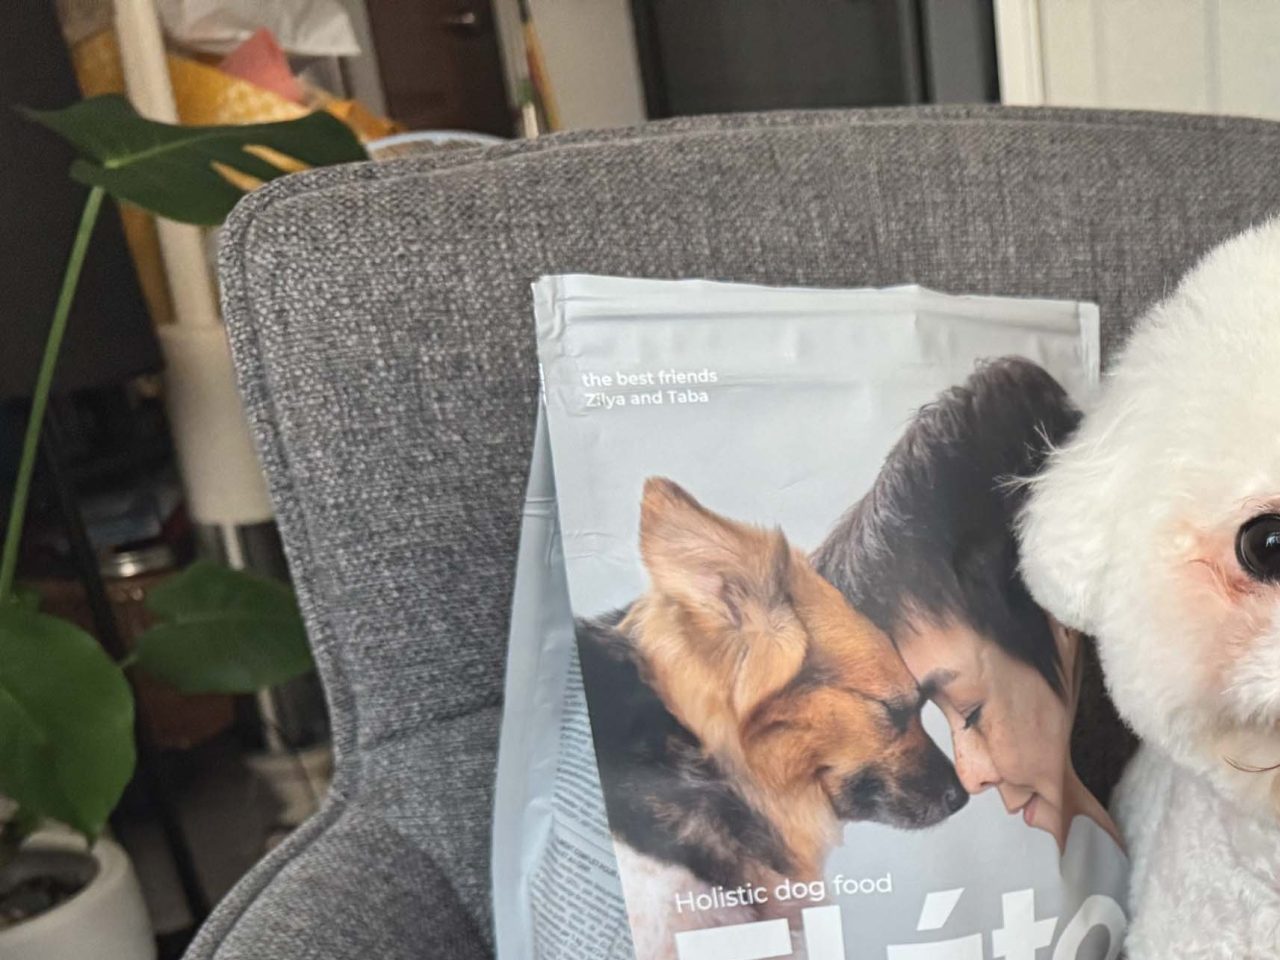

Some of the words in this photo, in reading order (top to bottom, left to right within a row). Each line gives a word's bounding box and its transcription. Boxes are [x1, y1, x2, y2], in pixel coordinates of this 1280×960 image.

[582, 372, 613, 388] the
[616, 371, 655, 386] best
[658, 368, 719, 385] friends
[584, 391, 626, 410] Zilya
[630, 390, 664, 405] and
[667, 389, 710, 405] Taba
[675, 883, 769, 913] Holistic
[774, 878, 826, 902] dog
[832, 872, 893, 895] food
